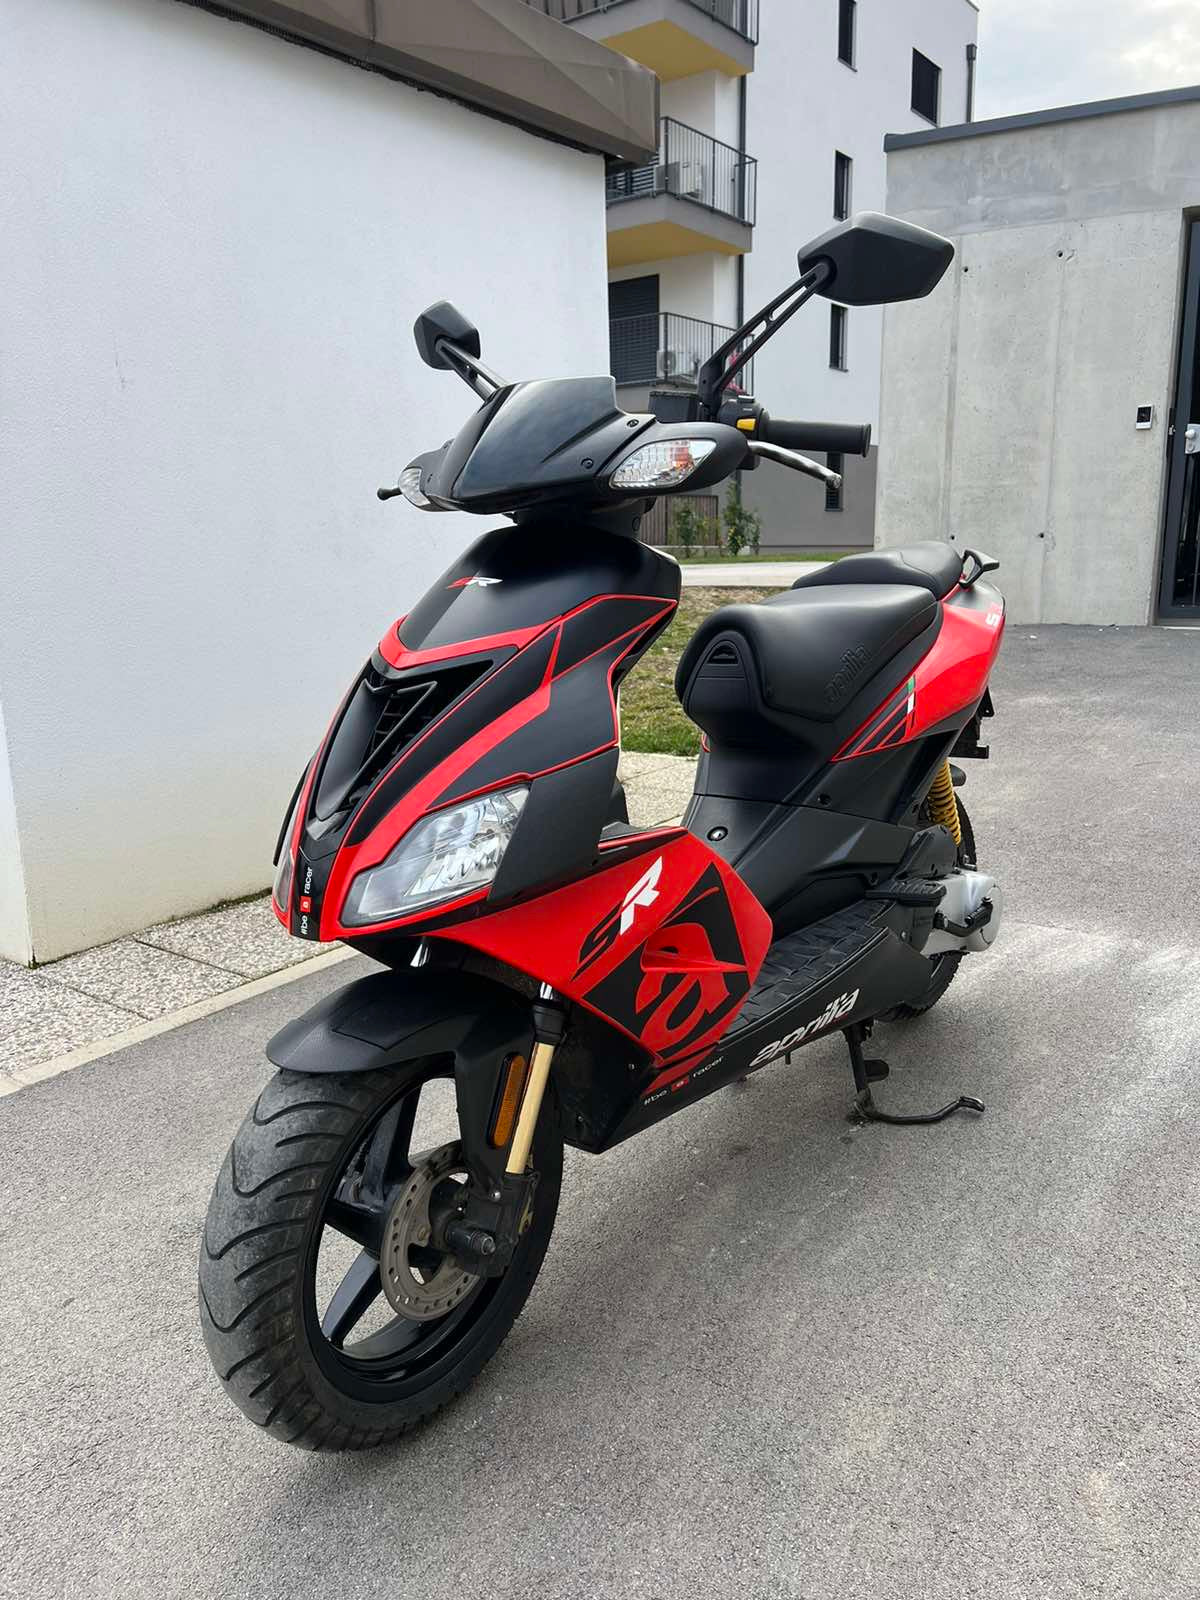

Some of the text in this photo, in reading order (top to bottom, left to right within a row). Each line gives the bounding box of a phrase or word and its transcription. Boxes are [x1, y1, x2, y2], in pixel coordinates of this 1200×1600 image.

[447, 576, 503, 589] SR
[304, 866, 313, 894] racer
[570, 855, 663, 982] SR
[748, 988, 860, 1067] aprilia
[693, 1055, 724, 1078] racer
